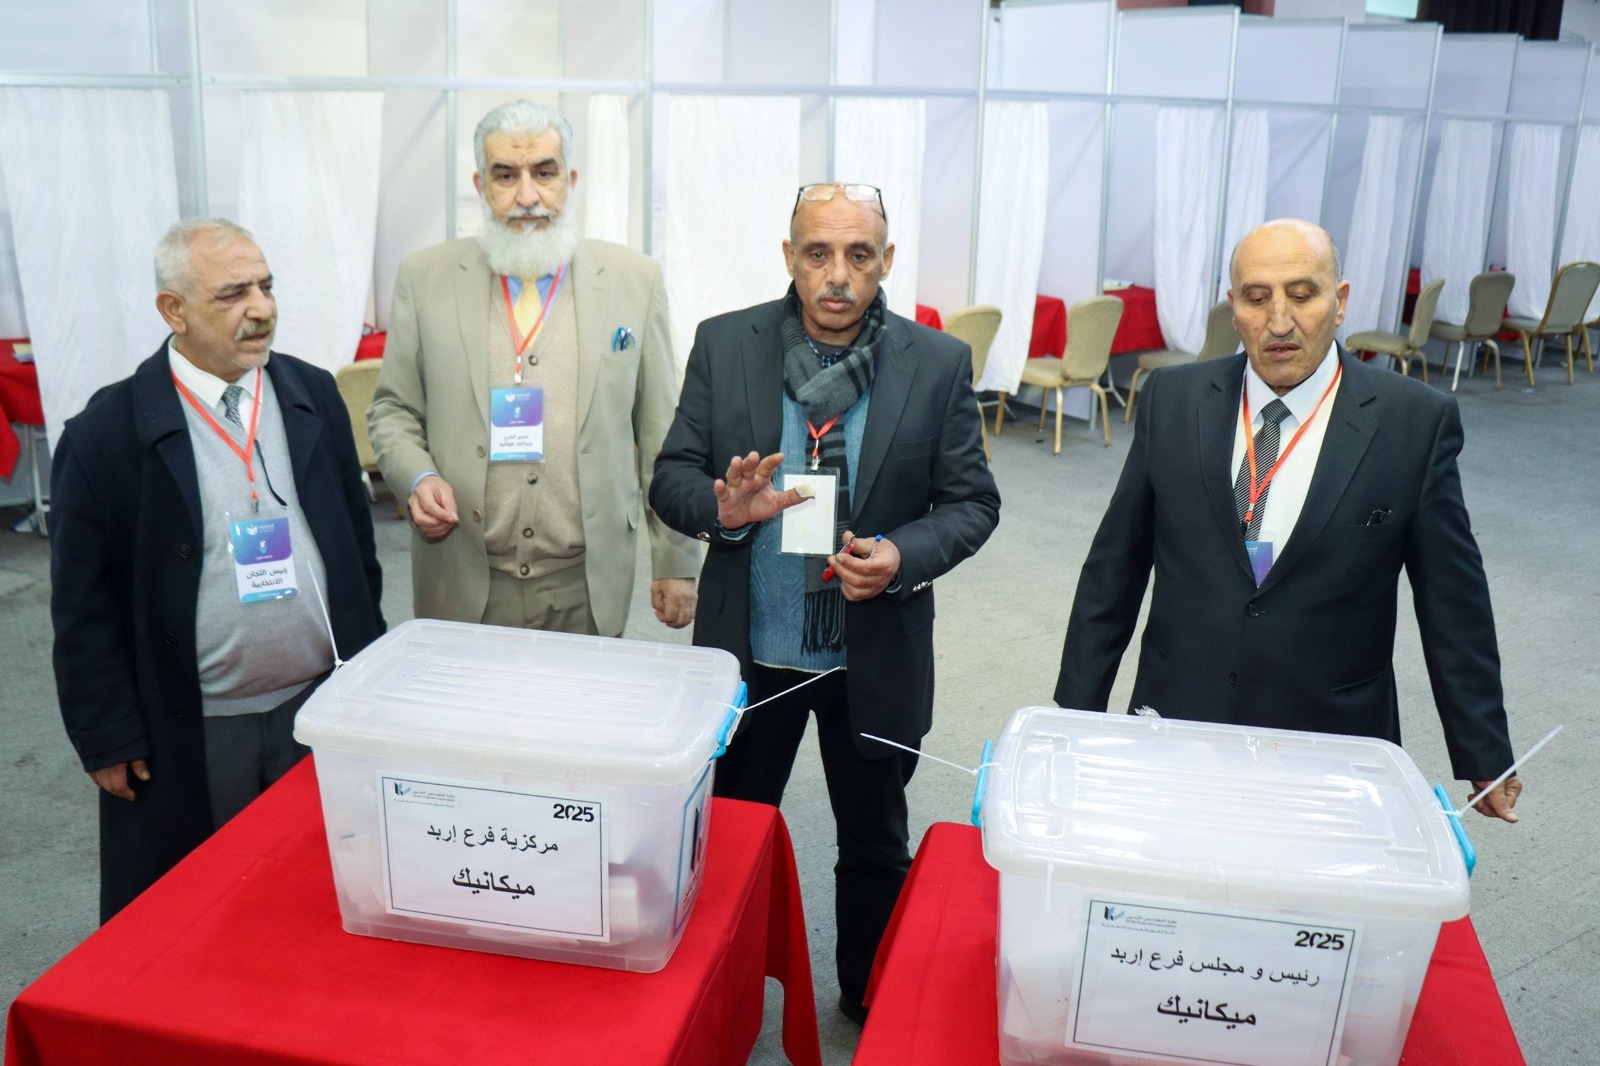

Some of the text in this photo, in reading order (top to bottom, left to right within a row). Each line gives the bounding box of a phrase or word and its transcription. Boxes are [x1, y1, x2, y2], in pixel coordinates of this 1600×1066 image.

[553, 803, 595, 822] 2025
[427, 824, 558, 854] مركزية فرع إربد
[452, 867, 536, 900] ميكانيك
[1294, 930, 1345, 950] 2025
[1110, 948, 1320, 986] رئيس و مجلس فرع إربد
[1156, 994, 1256, 1030] ميكانيك
